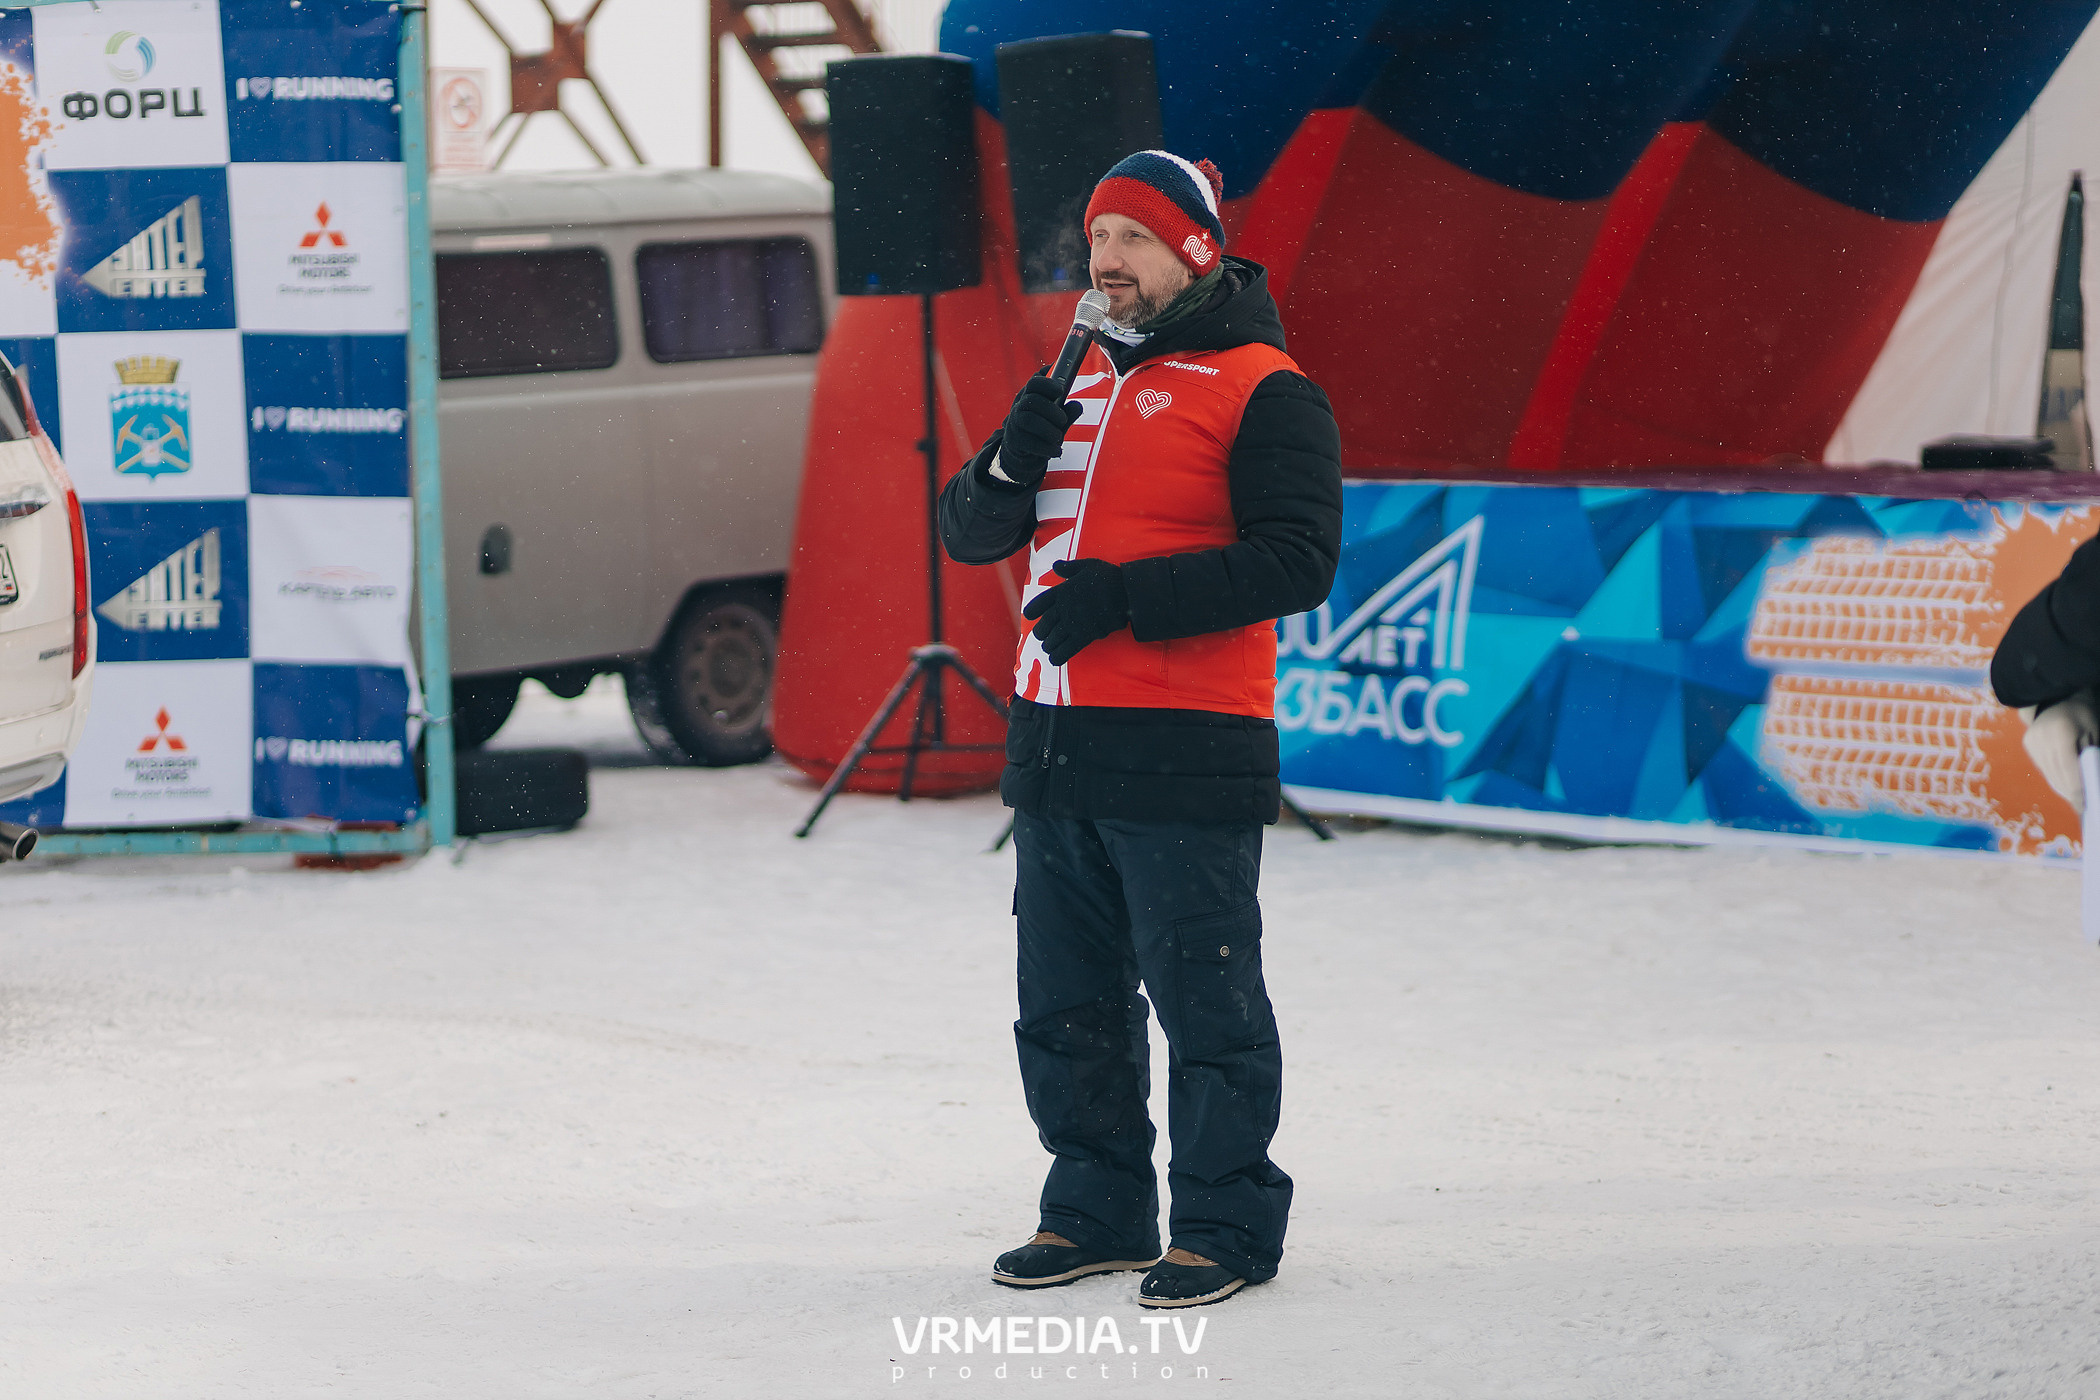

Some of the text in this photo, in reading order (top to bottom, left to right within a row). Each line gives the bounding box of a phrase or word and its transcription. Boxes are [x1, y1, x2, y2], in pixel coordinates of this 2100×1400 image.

[63, 87, 206, 120] ФОРЦ
[236, 76, 395, 102] I RUNNING
[286, 406, 405, 433] RUNNING
[1338, 624, 1427, 668] ЛЕТ
[287, 738, 405, 769] RUNNING
